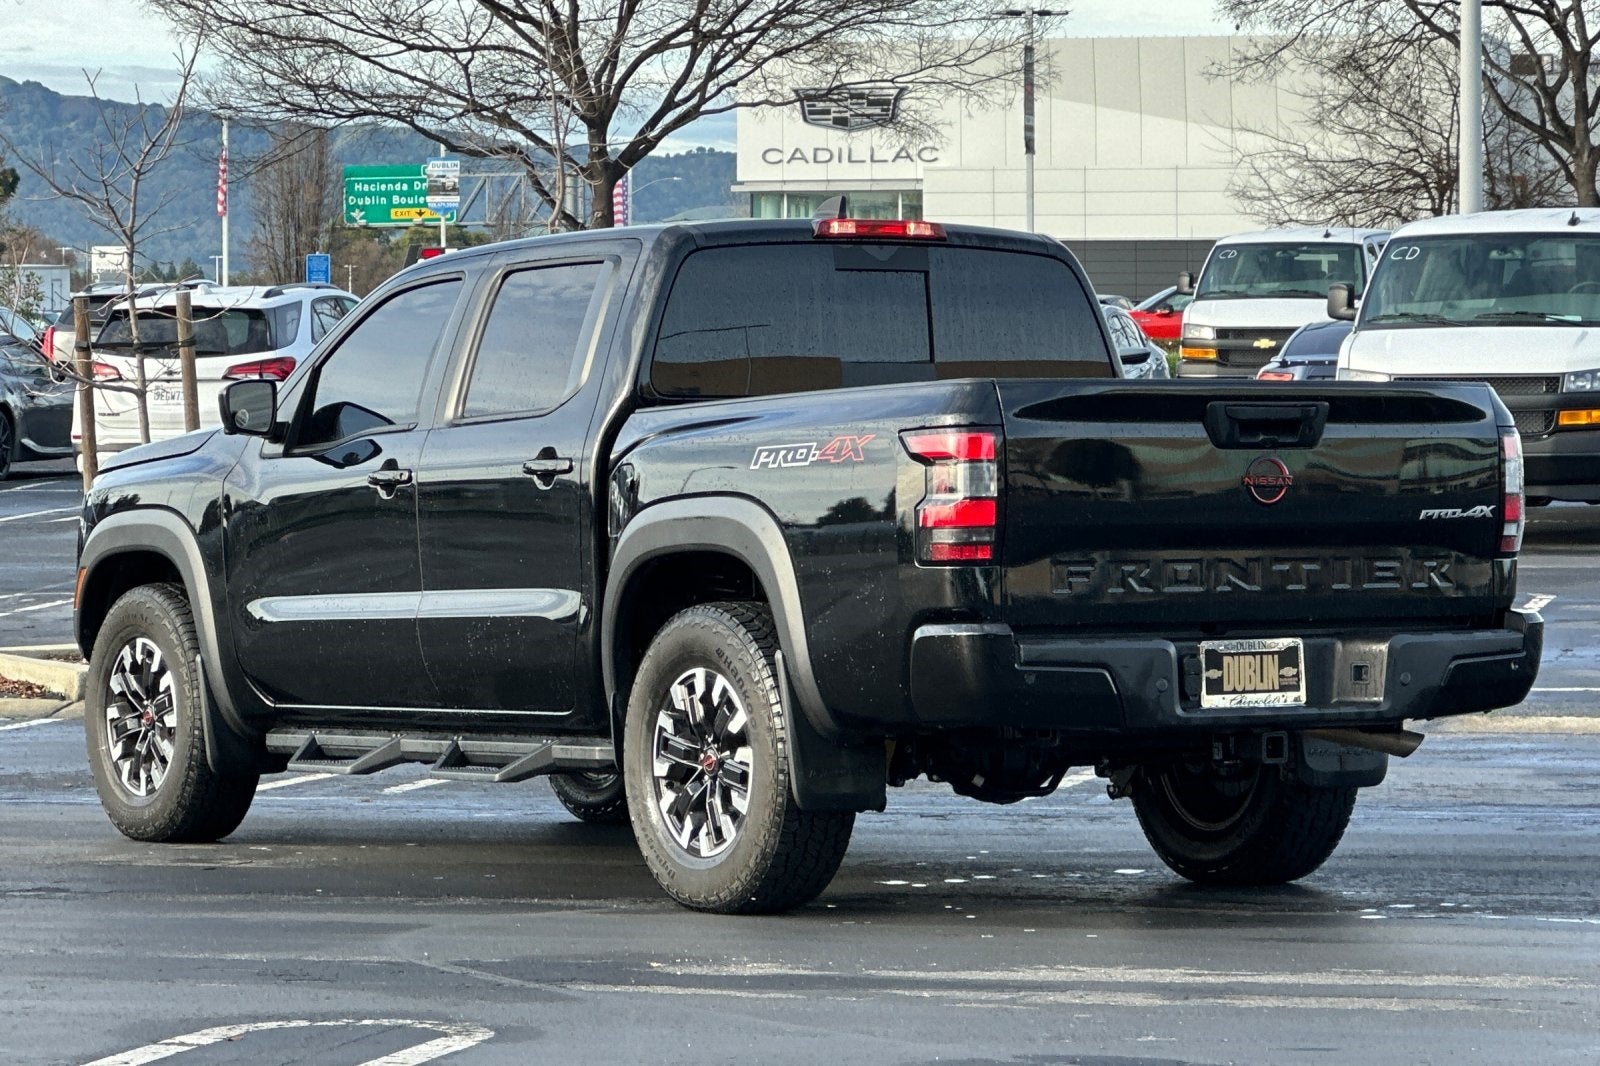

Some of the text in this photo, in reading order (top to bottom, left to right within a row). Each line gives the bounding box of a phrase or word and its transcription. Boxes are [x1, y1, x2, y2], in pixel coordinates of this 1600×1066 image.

[761, 146, 940, 165] CADILLAC
[354, 181, 428, 192] Hacienda Dr
[348, 196, 387, 205] Dublin
[392, 195, 428, 205] Boule
[1218, 249, 1239, 259] CD
[1390, 246, 1421, 261] CD
[1243, 476, 1293, 486] NISSAN
[1051, 556, 1458, 596] FRONTIER
[1236, 641, 1268, 651] DUBLIN
[1222, 654, 1280, 692] DUBLIN
